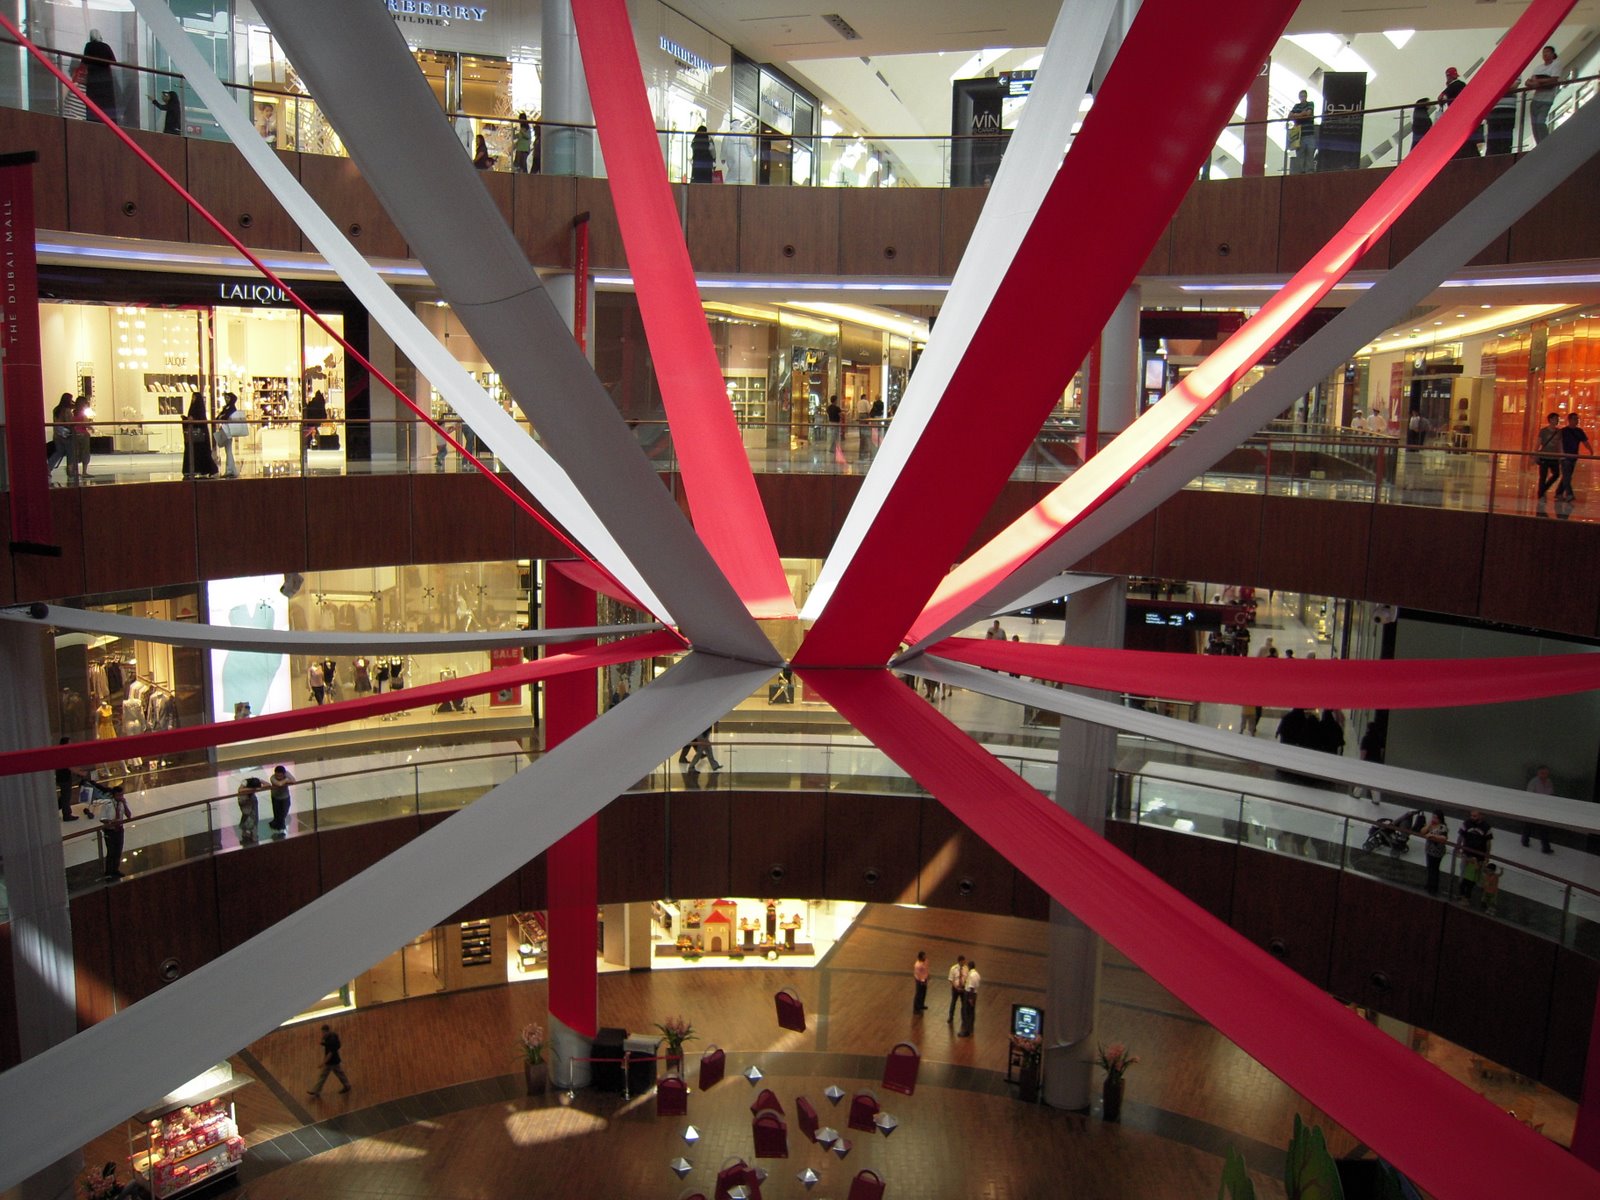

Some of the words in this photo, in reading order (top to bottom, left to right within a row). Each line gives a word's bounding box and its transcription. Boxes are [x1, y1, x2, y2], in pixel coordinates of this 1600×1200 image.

[384, 0, 487, 21] RBERRY
[393, 14, 451, 26] HILDREN
[4, 200, 13, 242] MALL
[6, 252, 16, 304] DUBAI
[9, 314, 17, 343] THE
[493, 649, 518, 658] SALE
